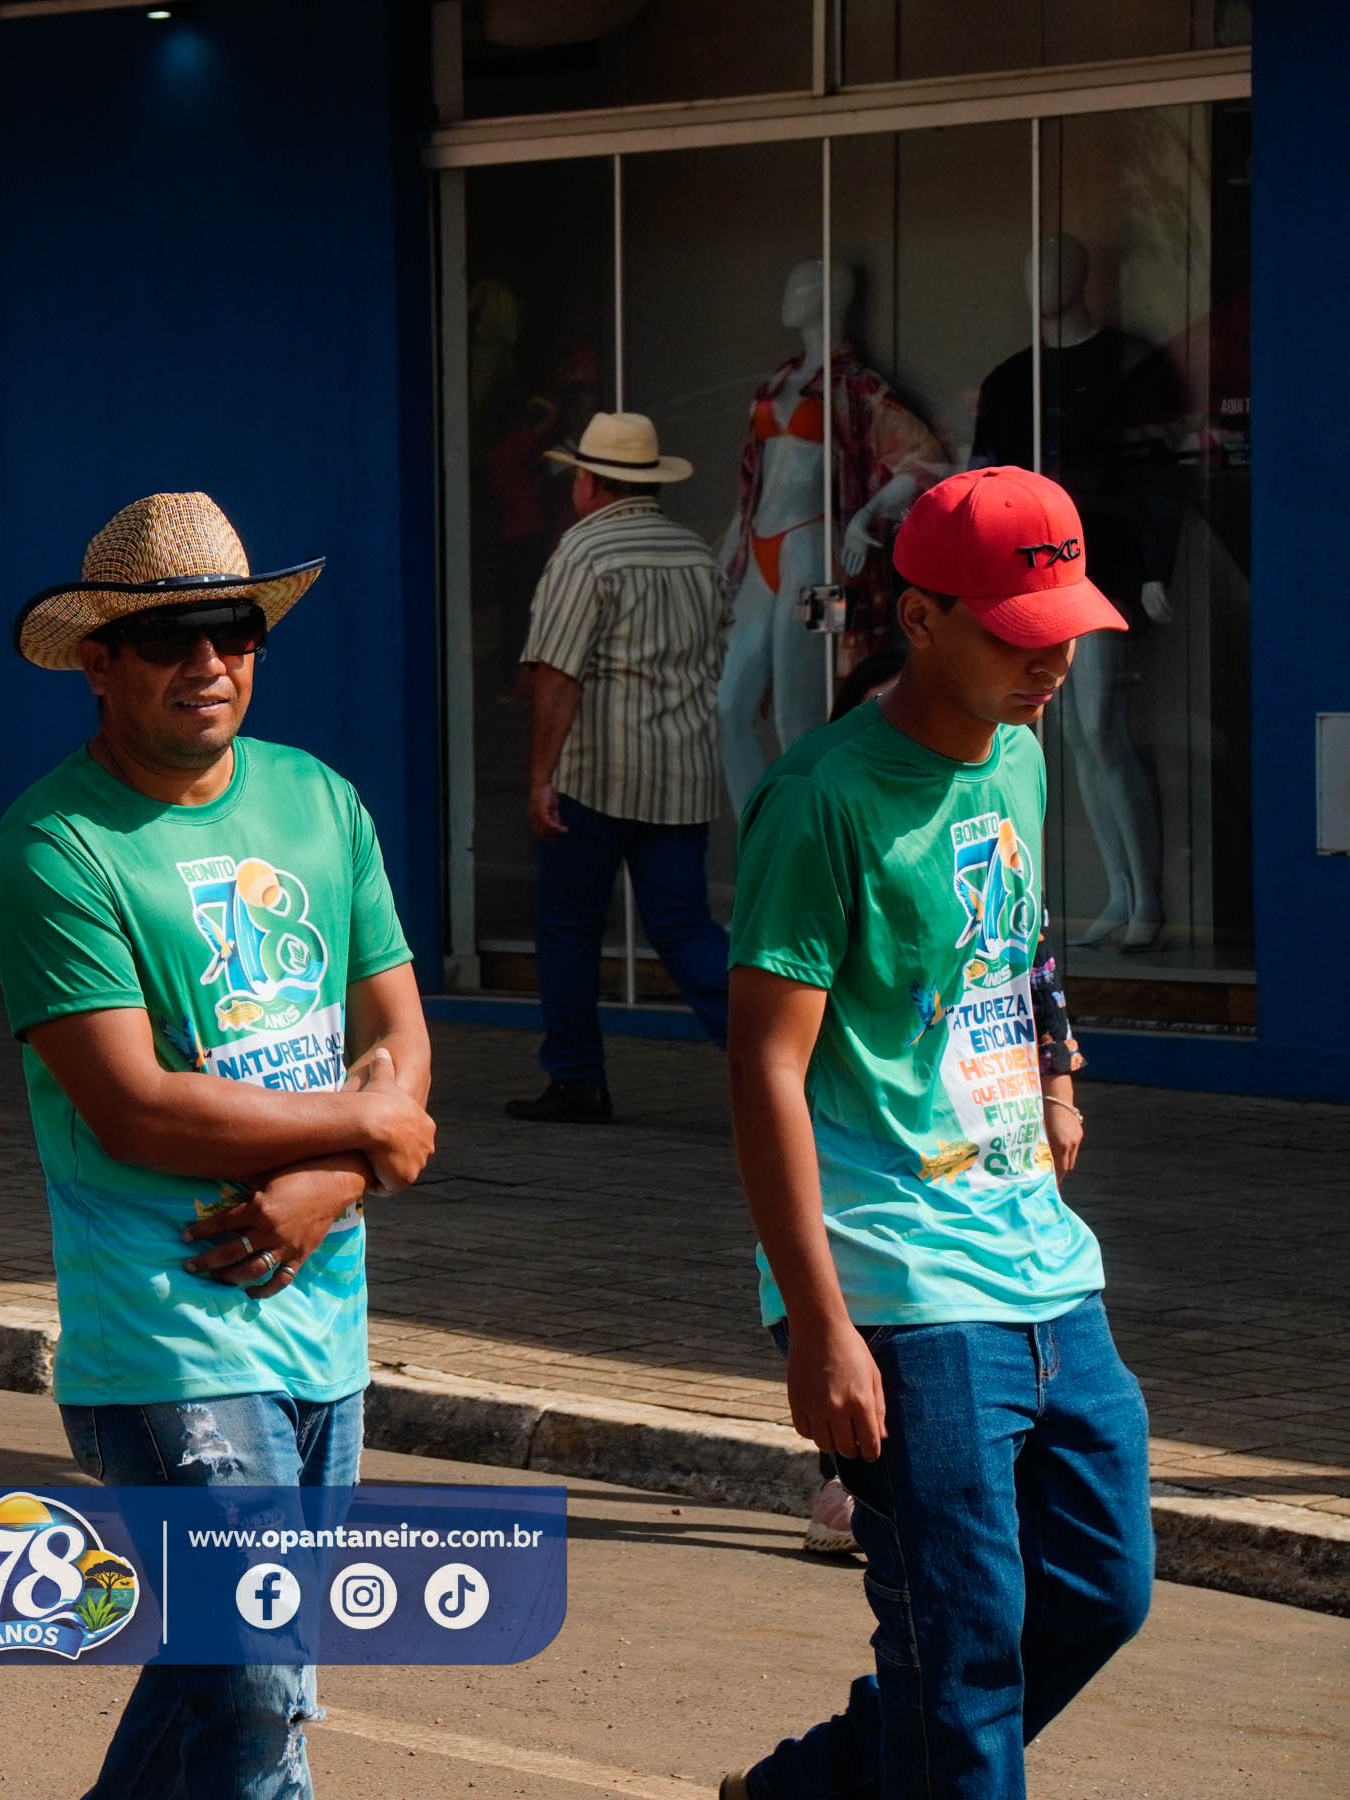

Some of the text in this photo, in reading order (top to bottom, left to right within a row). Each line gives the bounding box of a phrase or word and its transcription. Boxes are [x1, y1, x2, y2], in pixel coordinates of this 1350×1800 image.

[180, 859, 234, 883] BONITO
[264, 1004, 301, 1029] ANOS
[953, 993, 1029, 1031] ATUREZA
[969, 1018, 1036, 1054] ENCAN
[216, 1031, 342, 1081] NATUREZA QU
